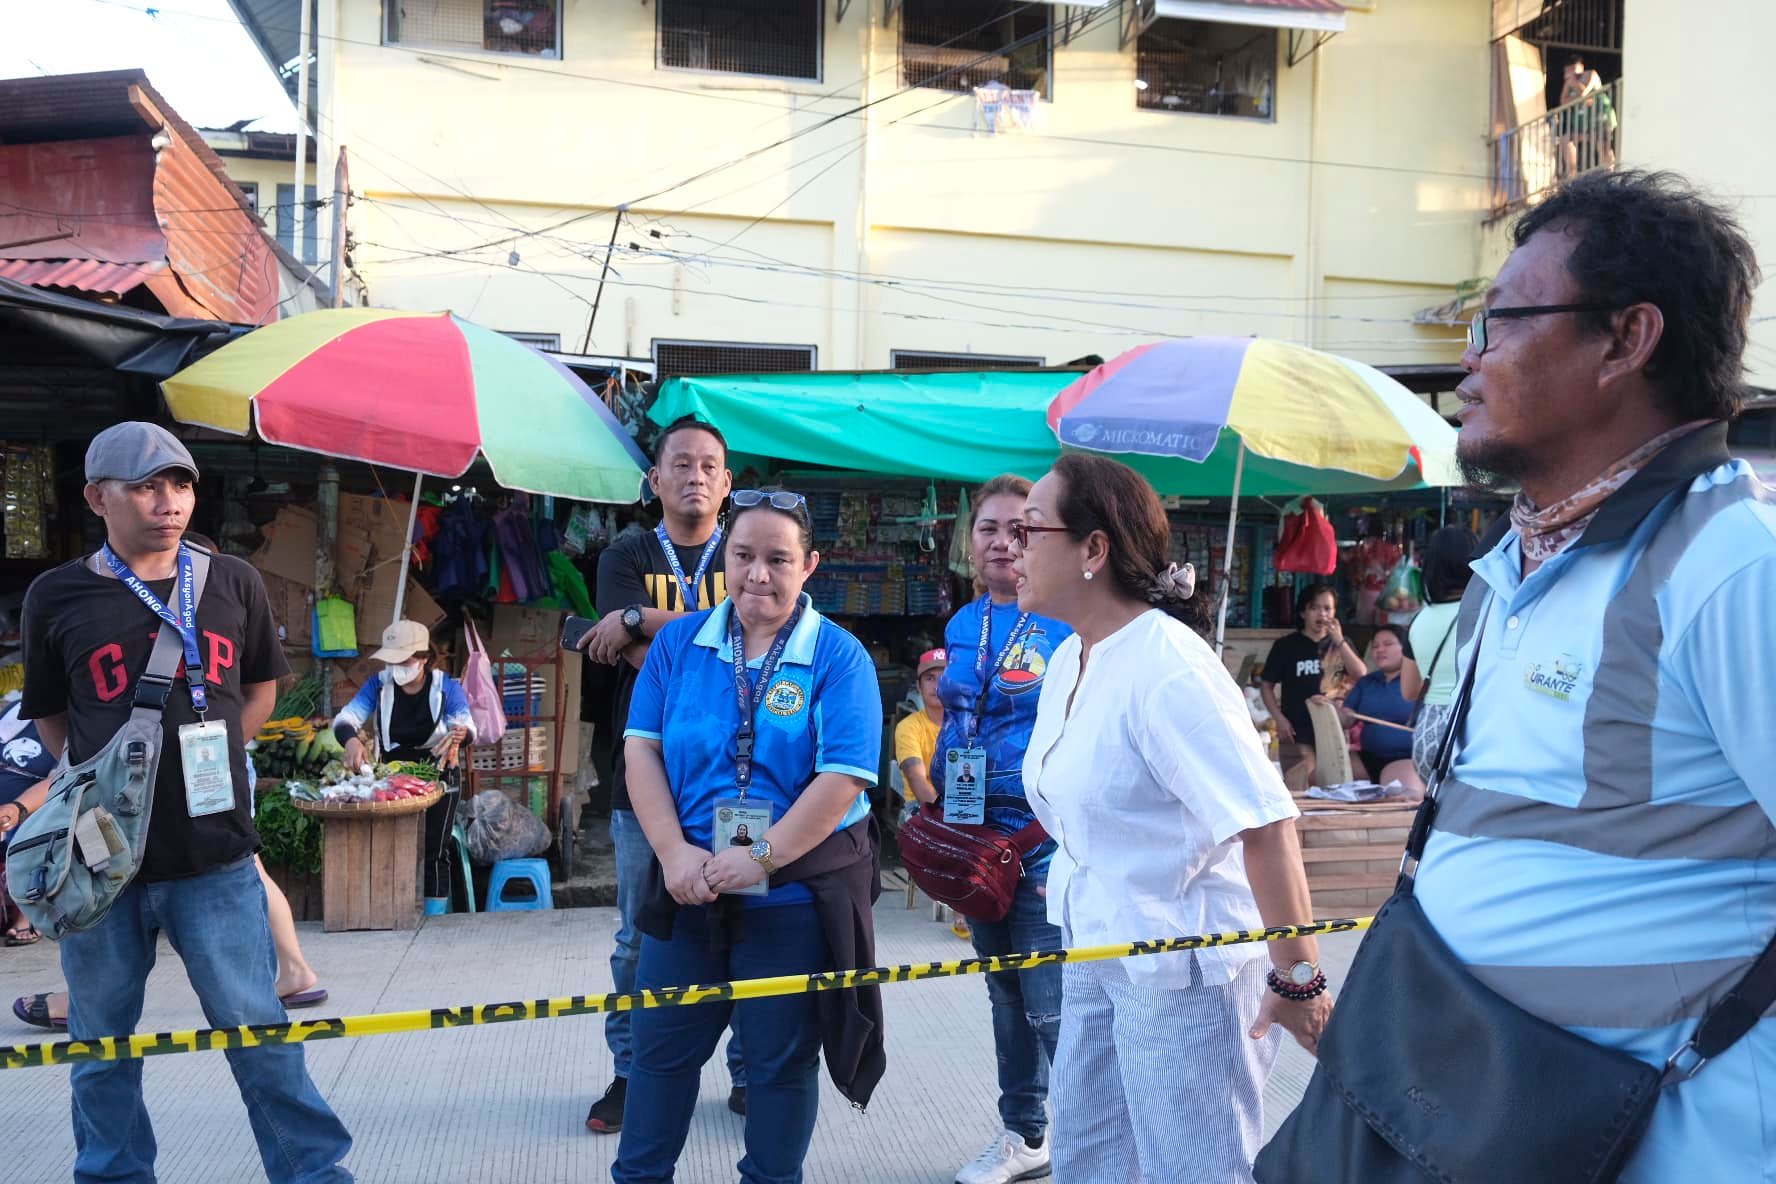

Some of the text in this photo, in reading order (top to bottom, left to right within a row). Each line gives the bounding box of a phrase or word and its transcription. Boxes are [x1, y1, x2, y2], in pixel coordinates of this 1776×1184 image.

[125, 576, 162, 613] AHONG
[182, 565, 196, 629] #AksyonAgad
[88, 629, 235, 703] GP
[733, 635, 744, 674] AHONG
[753, 638, 785, 703] #AksyonAgad
